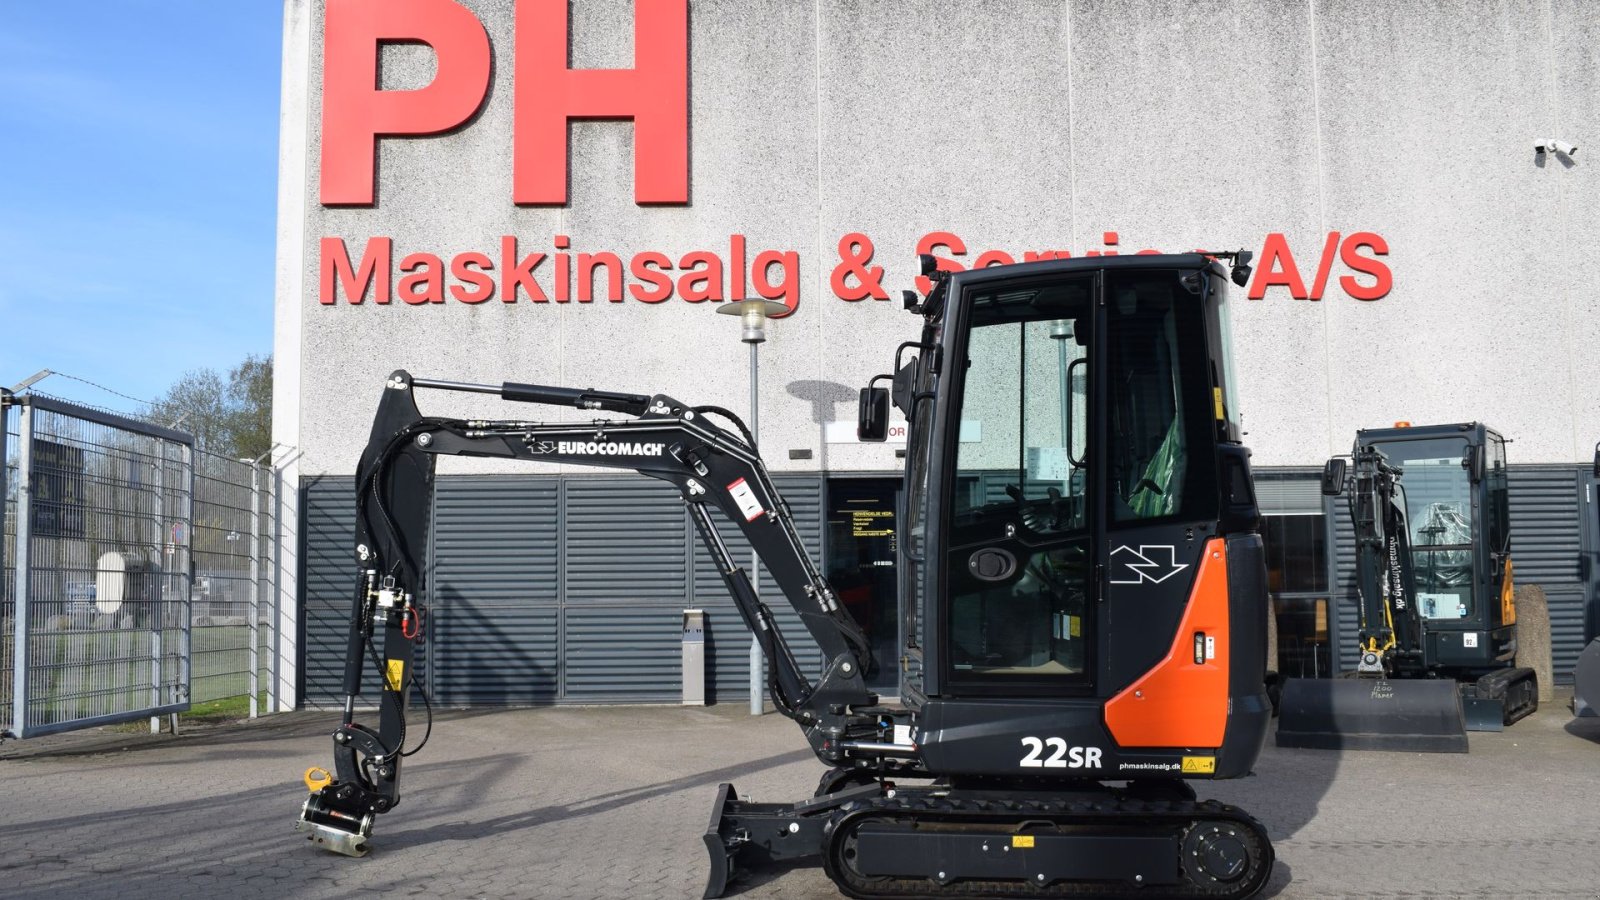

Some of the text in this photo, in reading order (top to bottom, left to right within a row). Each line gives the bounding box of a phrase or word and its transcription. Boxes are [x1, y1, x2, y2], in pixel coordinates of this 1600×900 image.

[320, 0, 689, 205] PH
[320, 233, 800, 317] Maskinsalg
[830, 231, 890, 301] &
[1248, 230, 1394, 300] A/S
[1020, 737, 1103, 769] 22SR
[1119, 762, 1181, 771] phmaskinsalg.dk
